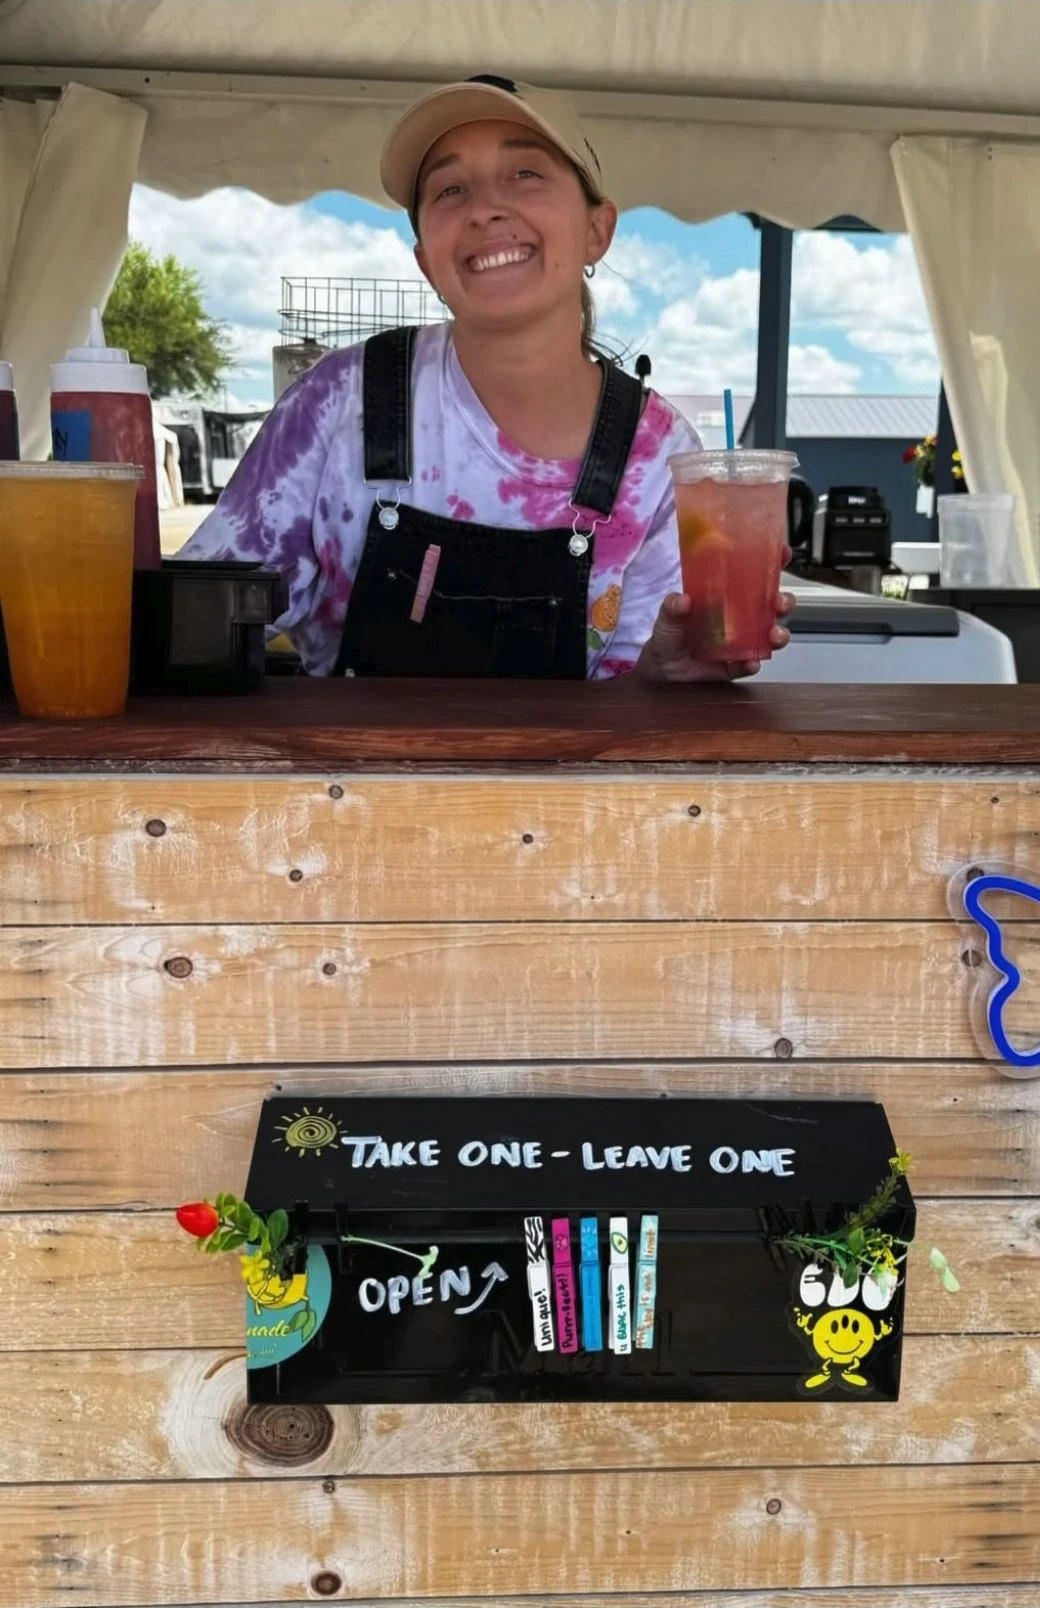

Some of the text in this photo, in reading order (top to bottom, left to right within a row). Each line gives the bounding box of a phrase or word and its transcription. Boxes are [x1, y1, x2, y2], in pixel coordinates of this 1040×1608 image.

[341, 1136, 441, 1168] TAKE
[457, 1140, 543, 1168] ONE
[581, 1141, 692, 1172] LEAVE
[709, 1146, 796, 1176] ONE
[358, 1265, 471, 1315] OPEN
[615, 1284, 627, 1309] this
[533, 1288, 552, 1346] Unique!
